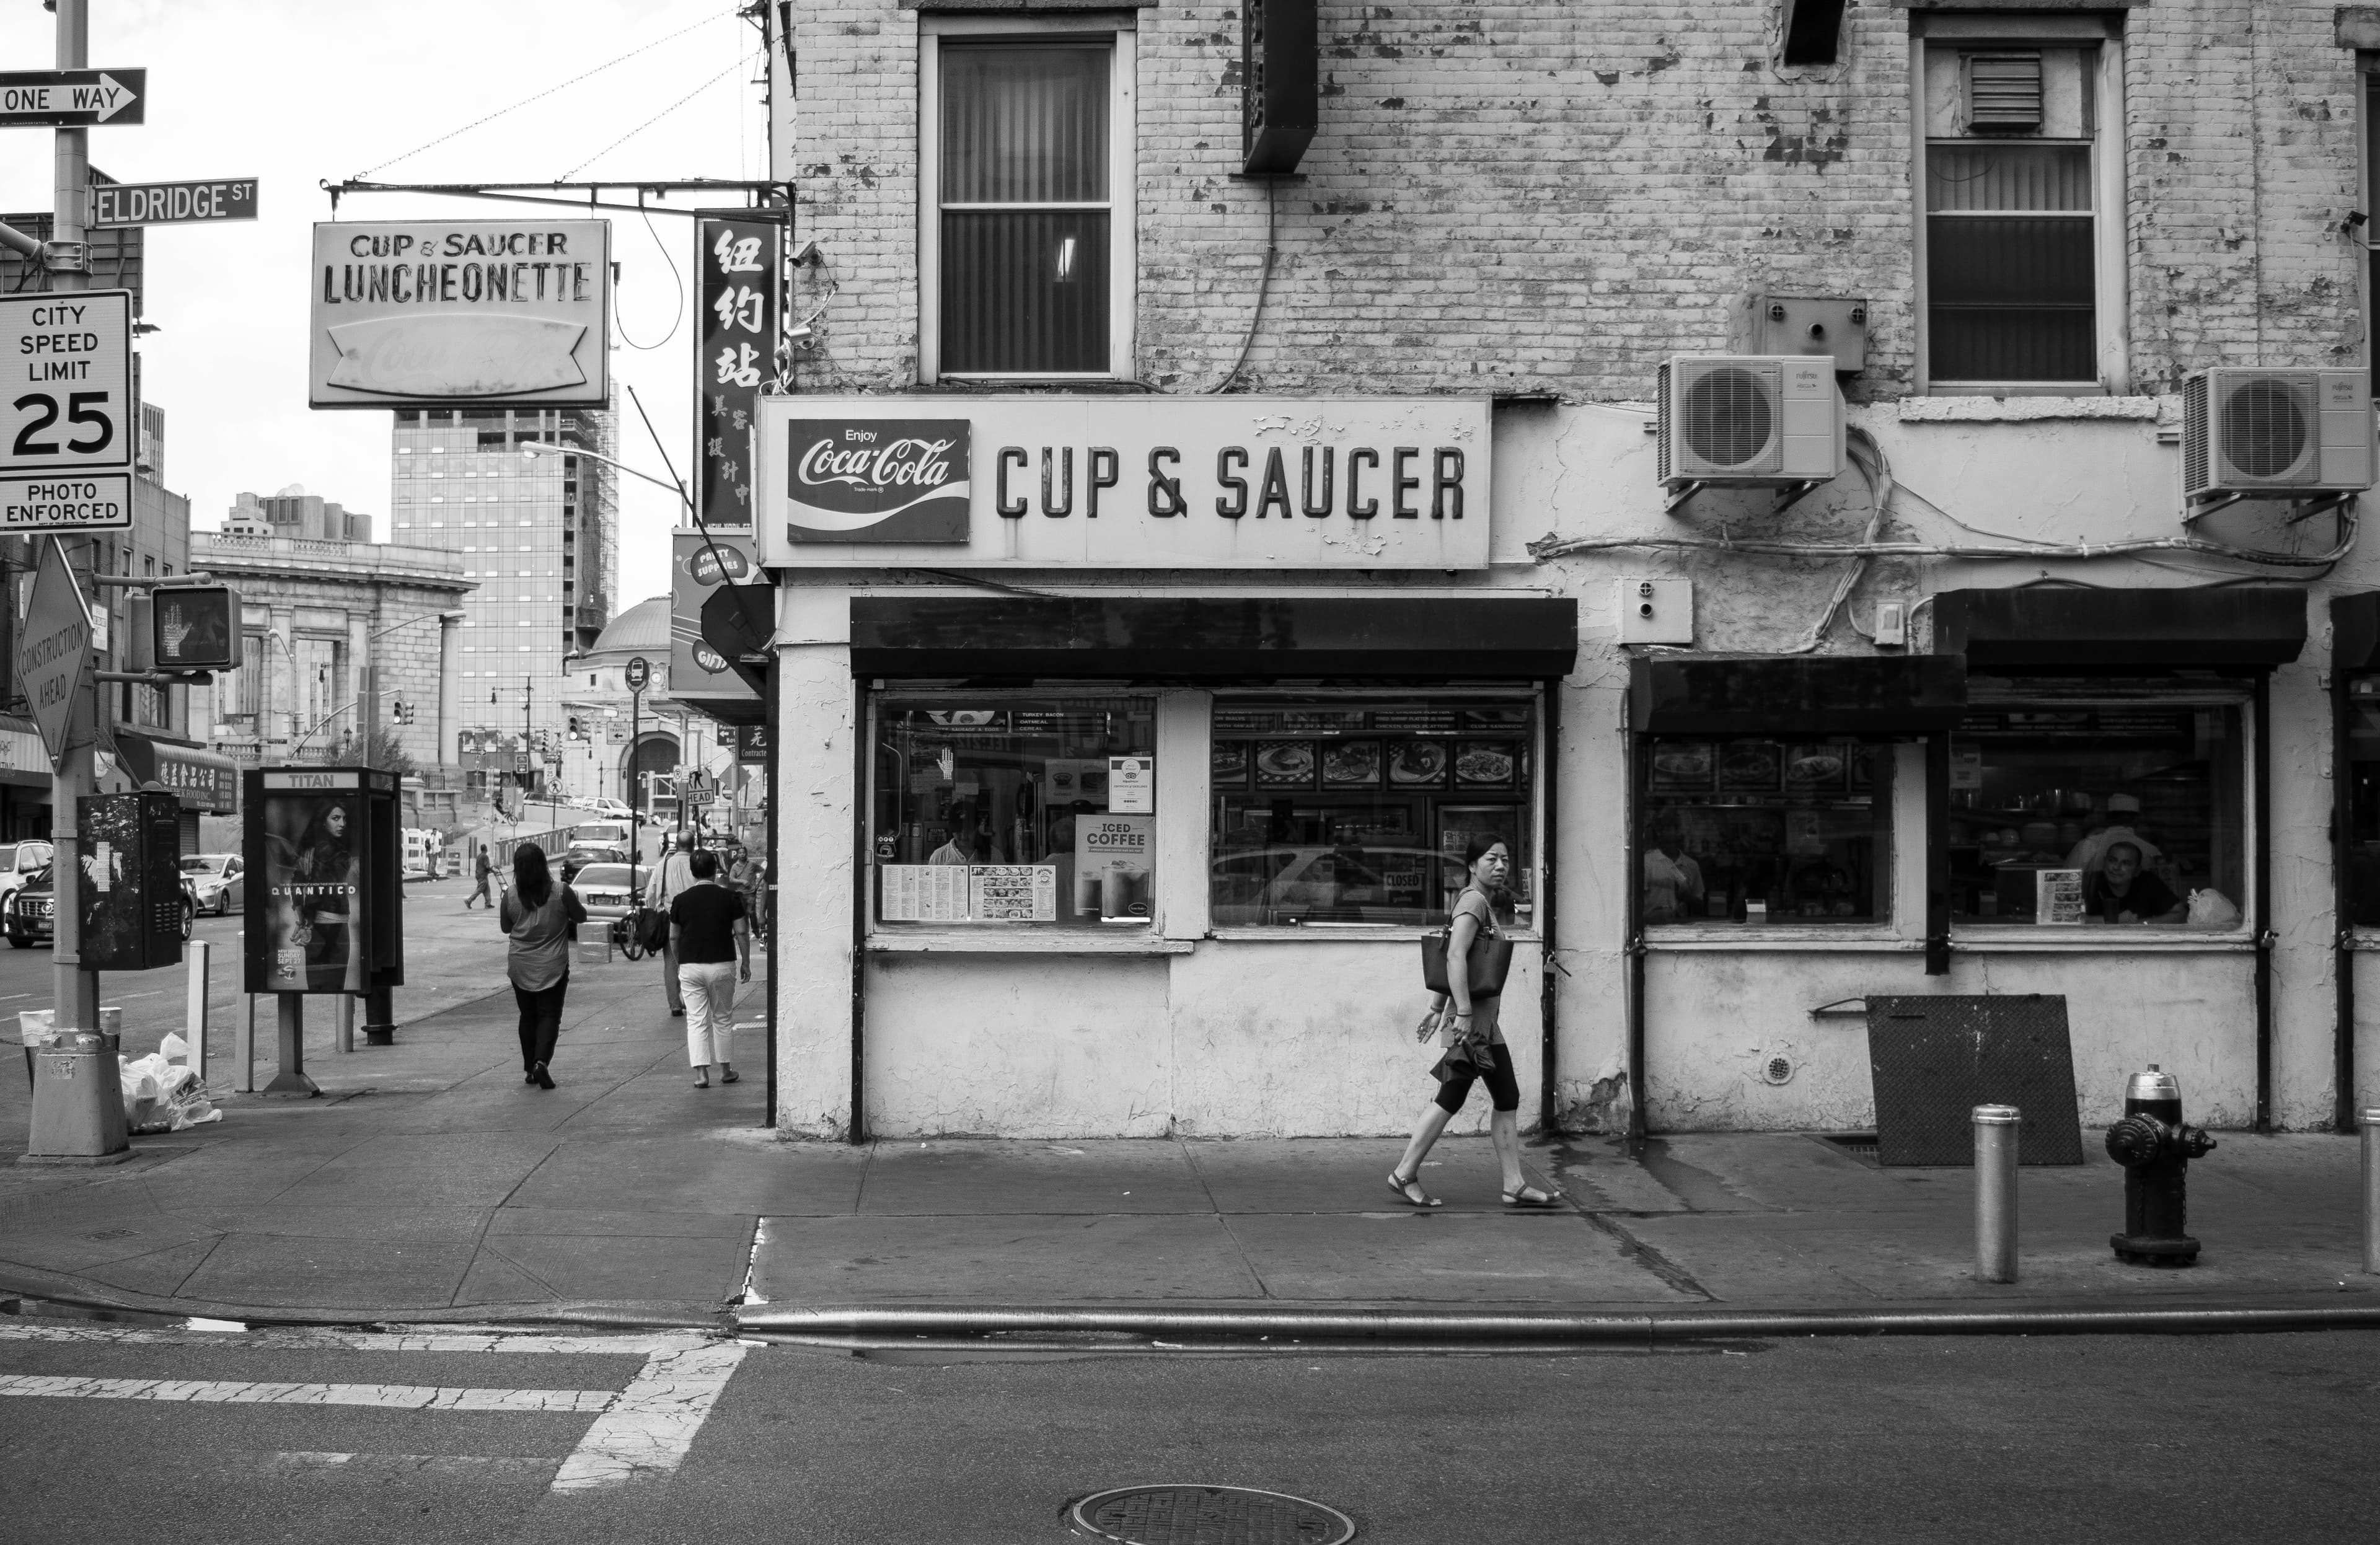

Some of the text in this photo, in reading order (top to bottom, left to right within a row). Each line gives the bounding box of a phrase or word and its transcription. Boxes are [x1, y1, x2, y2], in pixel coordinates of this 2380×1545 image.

[6, 87, 120, 110] ONE WAY
[97, 183, 253, 223] ELDRIDGE ST
[350, 232, 569, 257] CUP & SAUCER
[324, 262, 592, 304] LUNCHEONETTE
[32, 306, 87, 327] CITY
[20, 333, 99, 354] SPEED
[29, 361, 91, 382] LIMIT
[12, 392, 113, 456] 25
[845, 429, 878, 442] Enjoy
[798, 439, 957, 485] Coca-Cola
[28, 483, 97, 501] PHOTO
[996, 446, 1465, 519] CUP & SAUCER
[7, 503, 119, 522] ENFORCED
[698, 560, 738, 577] SUPPIES
[22, 620, 84, 676] CONSTRUCTION
[40, 674, 66, 710] AHEAD
[288, 775, 334, 788] TITAN
[187, 788, 201, 799] FOOD
[689, 792, 710, 803] HEAD
[1102, 823, 1131, 833] ICED
[1086, 832, 1145, 846] COFFEE
[1386, 874, 1419, 886] CLOSED
[271, 886, 356, 896] QUANTICO
